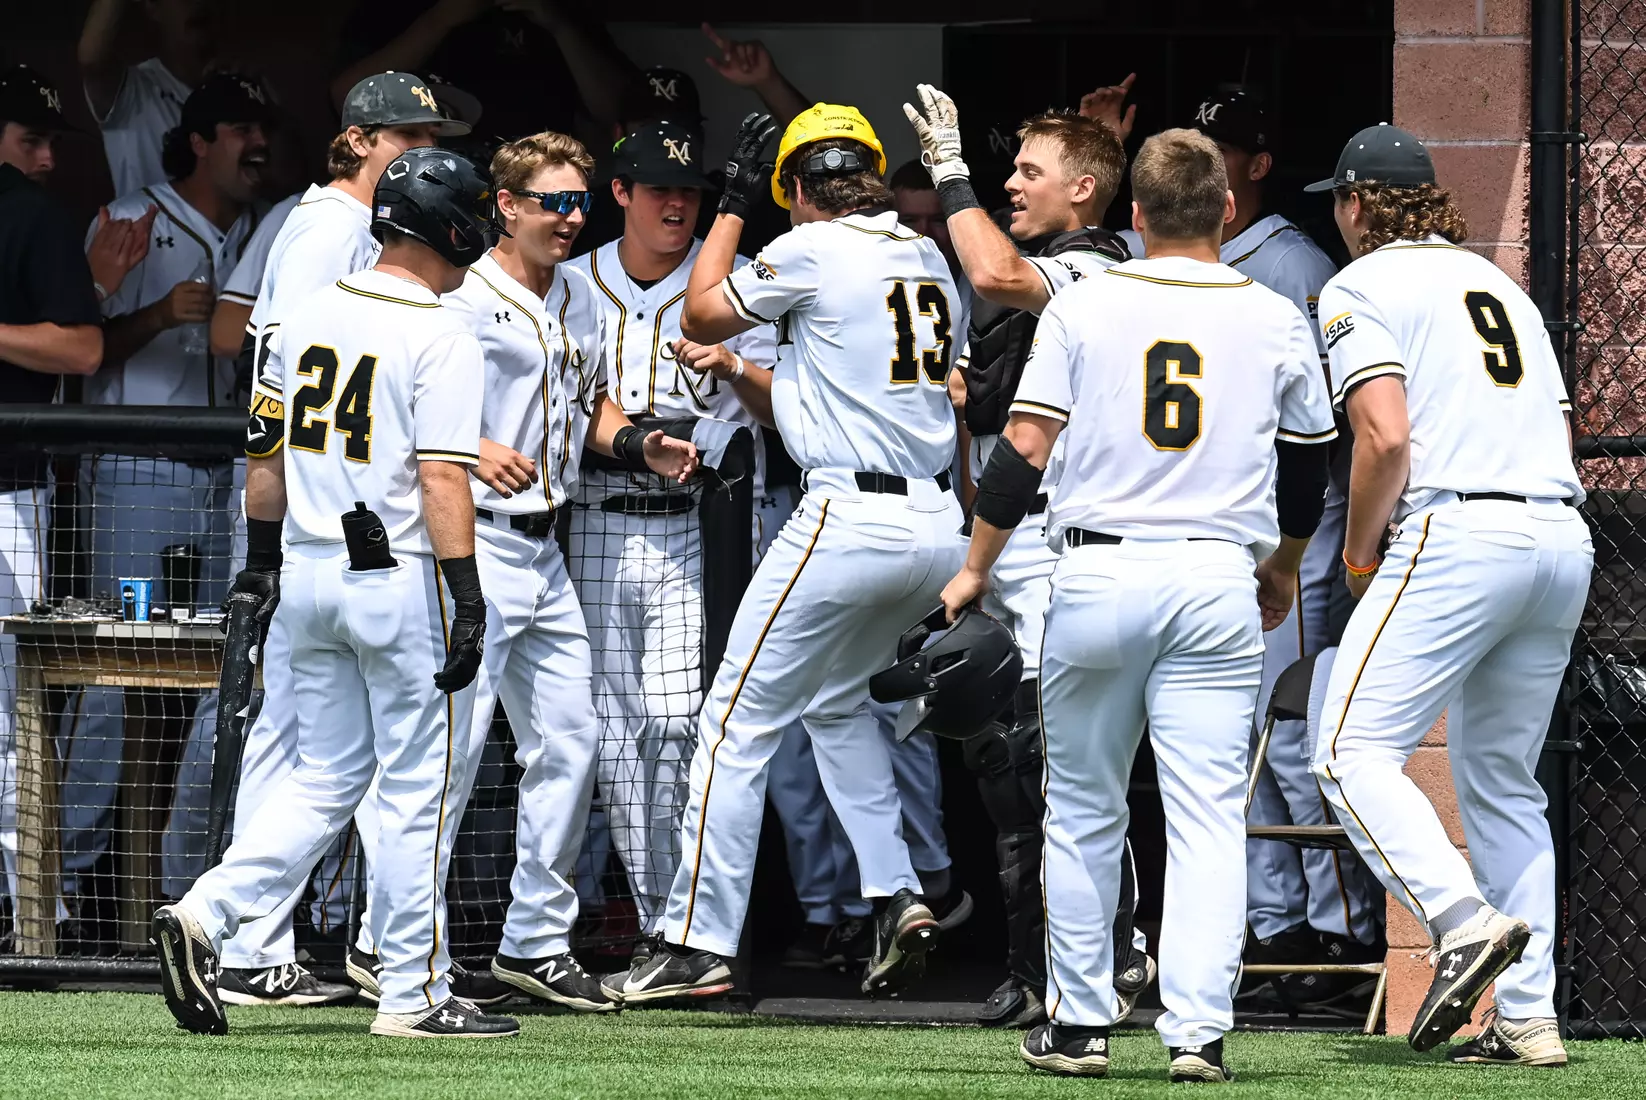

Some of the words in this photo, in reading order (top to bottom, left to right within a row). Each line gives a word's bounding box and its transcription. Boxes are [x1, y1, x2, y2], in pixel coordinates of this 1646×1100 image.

[663, 138, 693, 166] M
[885, 279, 952, 384] 13
[1463, 289, 1524, 389] 9
[288, 343, 379, 464] 24
[1142, 338, 1203, 451] 6
[1520, 1028, 1547, 1043] UNDER
